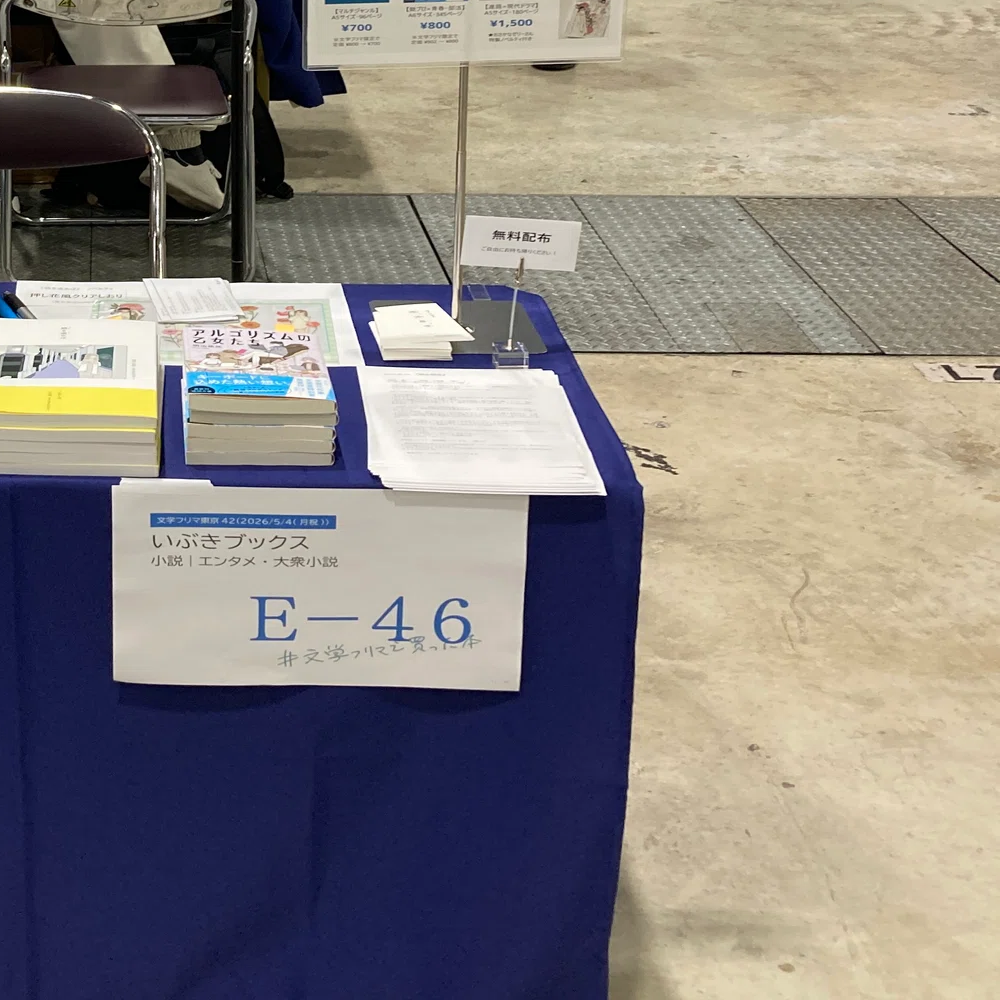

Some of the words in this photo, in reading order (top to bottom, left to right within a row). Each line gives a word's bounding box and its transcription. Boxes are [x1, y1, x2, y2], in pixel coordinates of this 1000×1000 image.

[341, 23, 372, 31] ¥700
[420, 21, 451, 29] ¥800
[490, 19, 533, 28] ¥1,500
[491, 229, 553, 244] 無料配布
[192, 329, 311, 342] アルゴリズムの
[192, 336, 261, 346] 乙女たち
[156, 516, 219, 525] 文学フリマ東京
[152, 533, 310, 550] いぶきブックス
